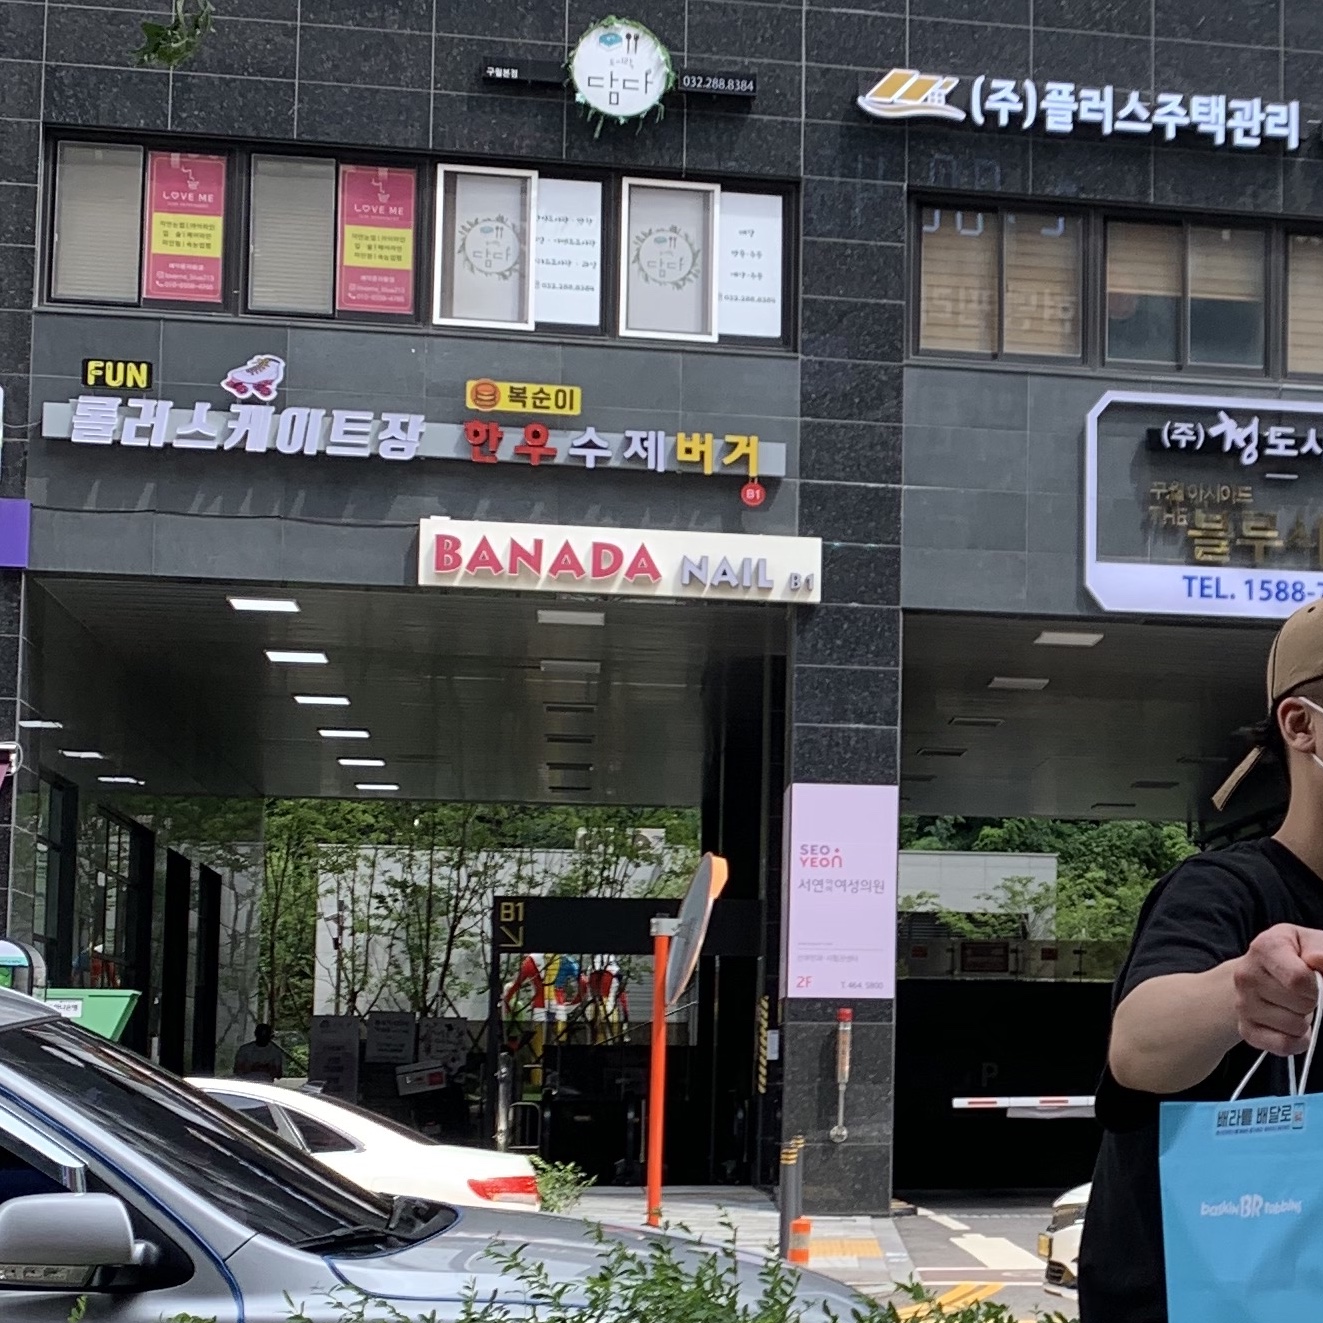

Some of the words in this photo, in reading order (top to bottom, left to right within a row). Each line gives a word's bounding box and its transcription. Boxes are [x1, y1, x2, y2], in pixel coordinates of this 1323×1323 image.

[588, 70, 653, 105] 담다
[683, 77, 754, 92] 032.288.8384
[971, 74, 1299, 150] (주)플러스주택관리
[162, 191, 194, 202] LOVE
[198, 194, 214, 203] ME
[354, 204, 385, 214] LOVE
[389, 206, 404, 216] ME
[87, 360, 148, 389] FUN
[508, 386, 574, 410] 복순이
[71, 395, 425, 460] 롤러스케이트장
[745, 488, 761, 501] B1
[433, 533, 662, 583] BANADA
[681, 555, 774, 589] NAIL
[789, 572, 814, 591] B1
[1182, 575, 1236, 600] TEL.
[800, 844, 831, 856] SEO
[500, 902, 525, 922] B1
[796, 975, 813, 988] 2F
[1216, 1108, 1253, 1127] 배라를
[1256, 1105, 1293, 1124] 배달로
[1240, 1194, 1263, 1217] BR
